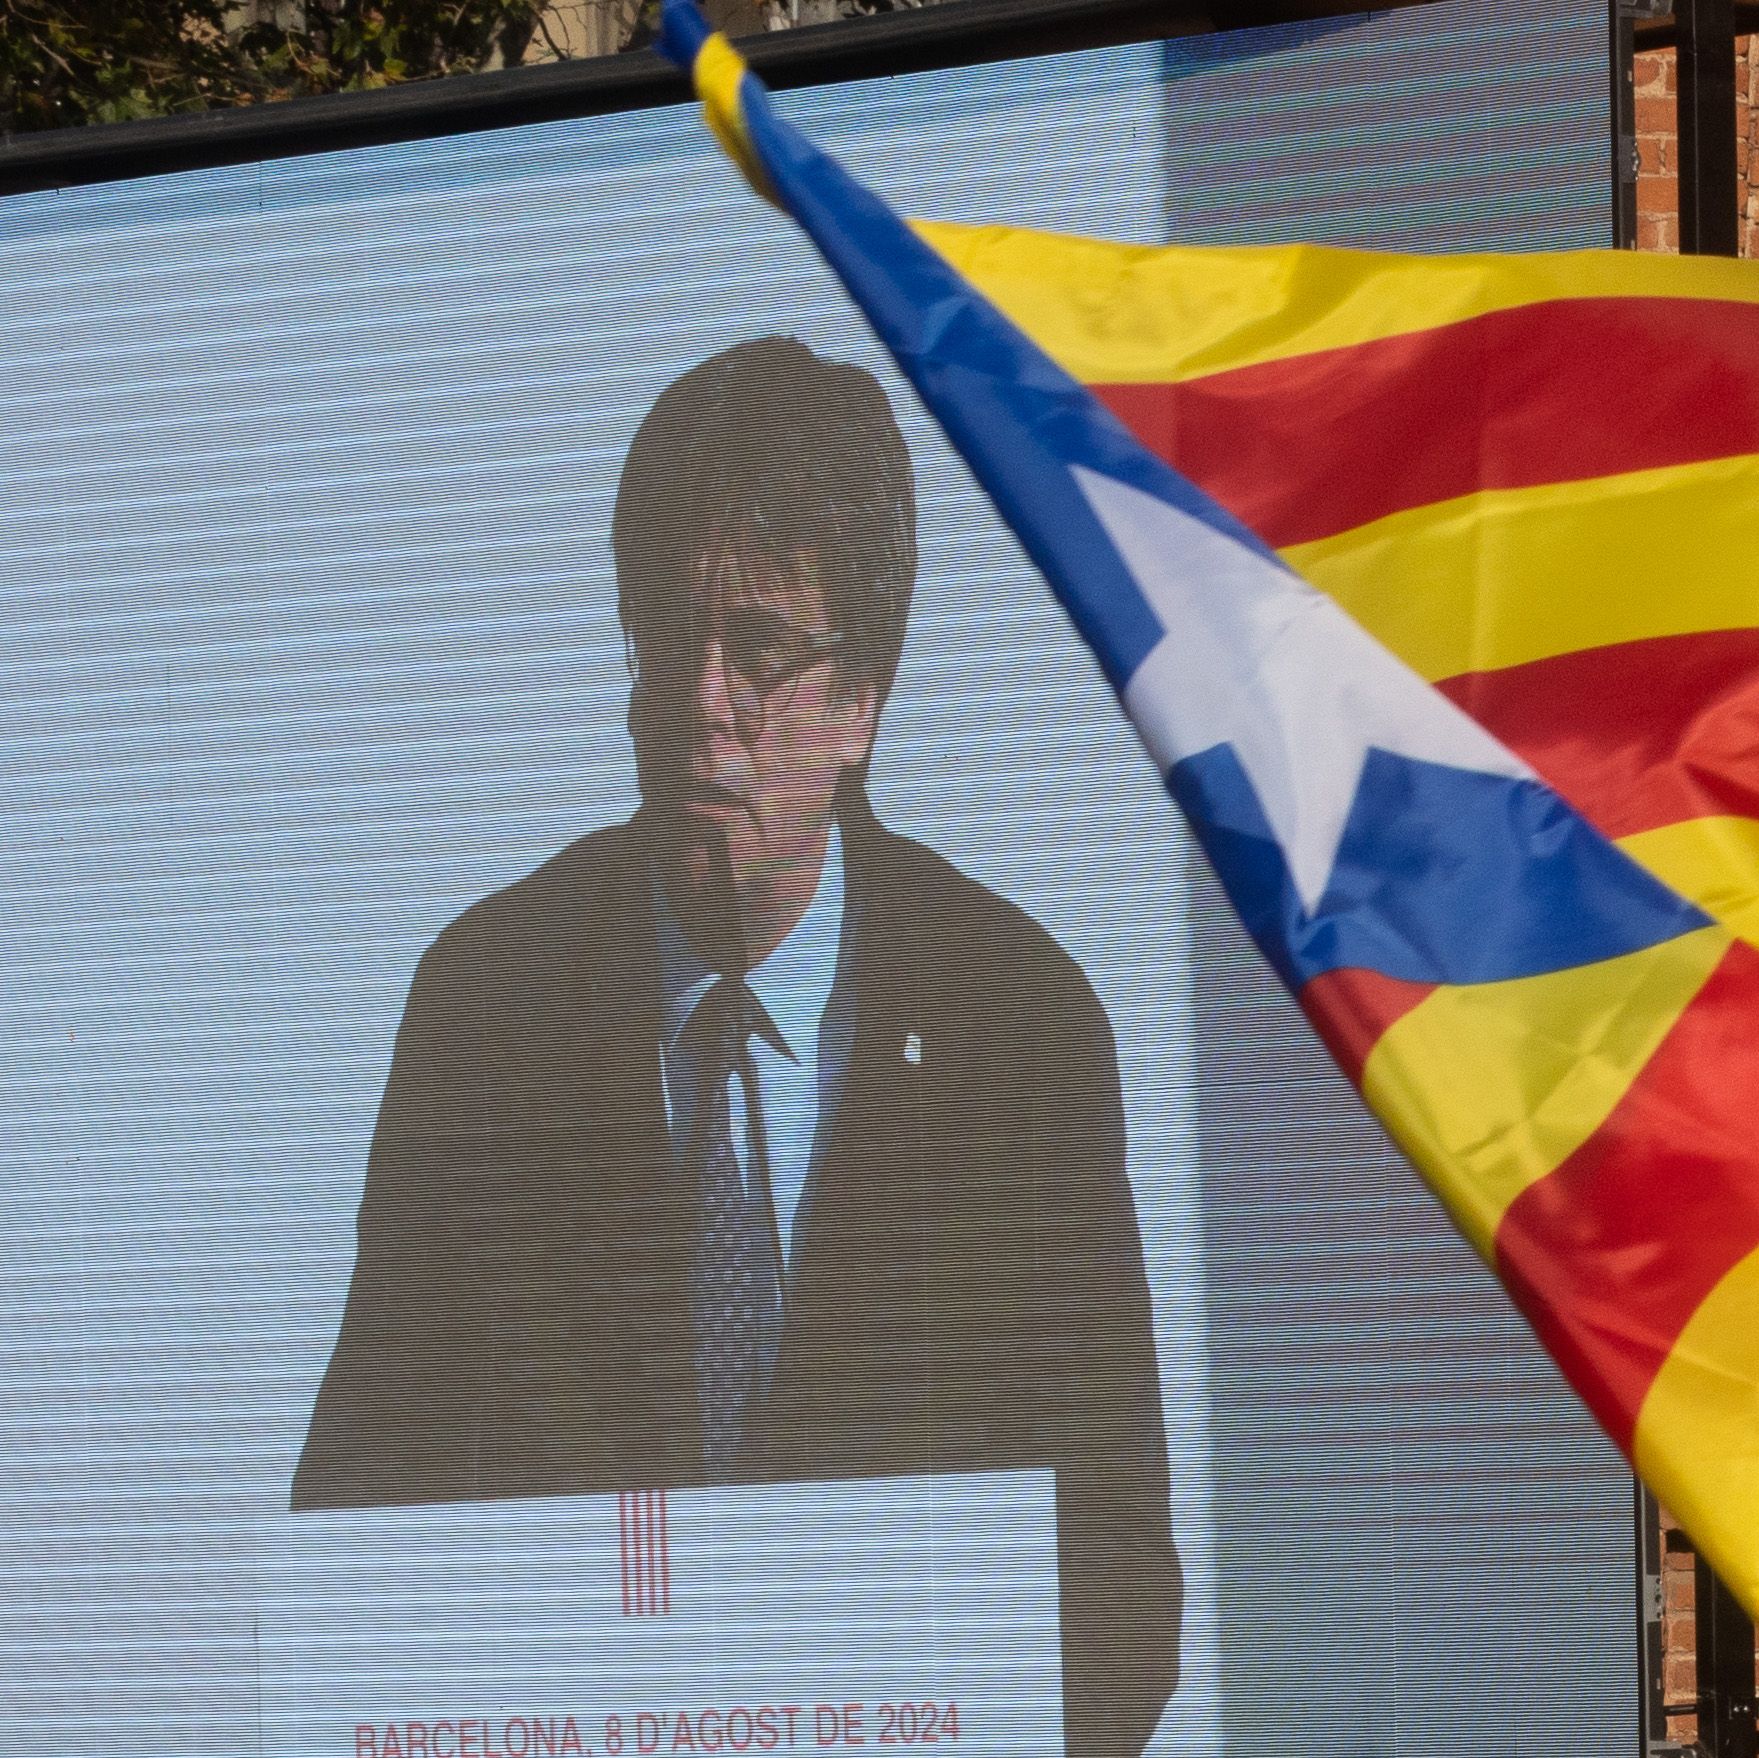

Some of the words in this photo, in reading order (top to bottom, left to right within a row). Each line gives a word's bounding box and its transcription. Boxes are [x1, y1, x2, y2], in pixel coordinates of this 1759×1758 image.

[604, 1713, 624, 1756] 8
[635, 1706, 801, 1754] D'AGOST
[814, 1703, 865, 1745] DE
[878, 1700, 961, 1744] 2024
